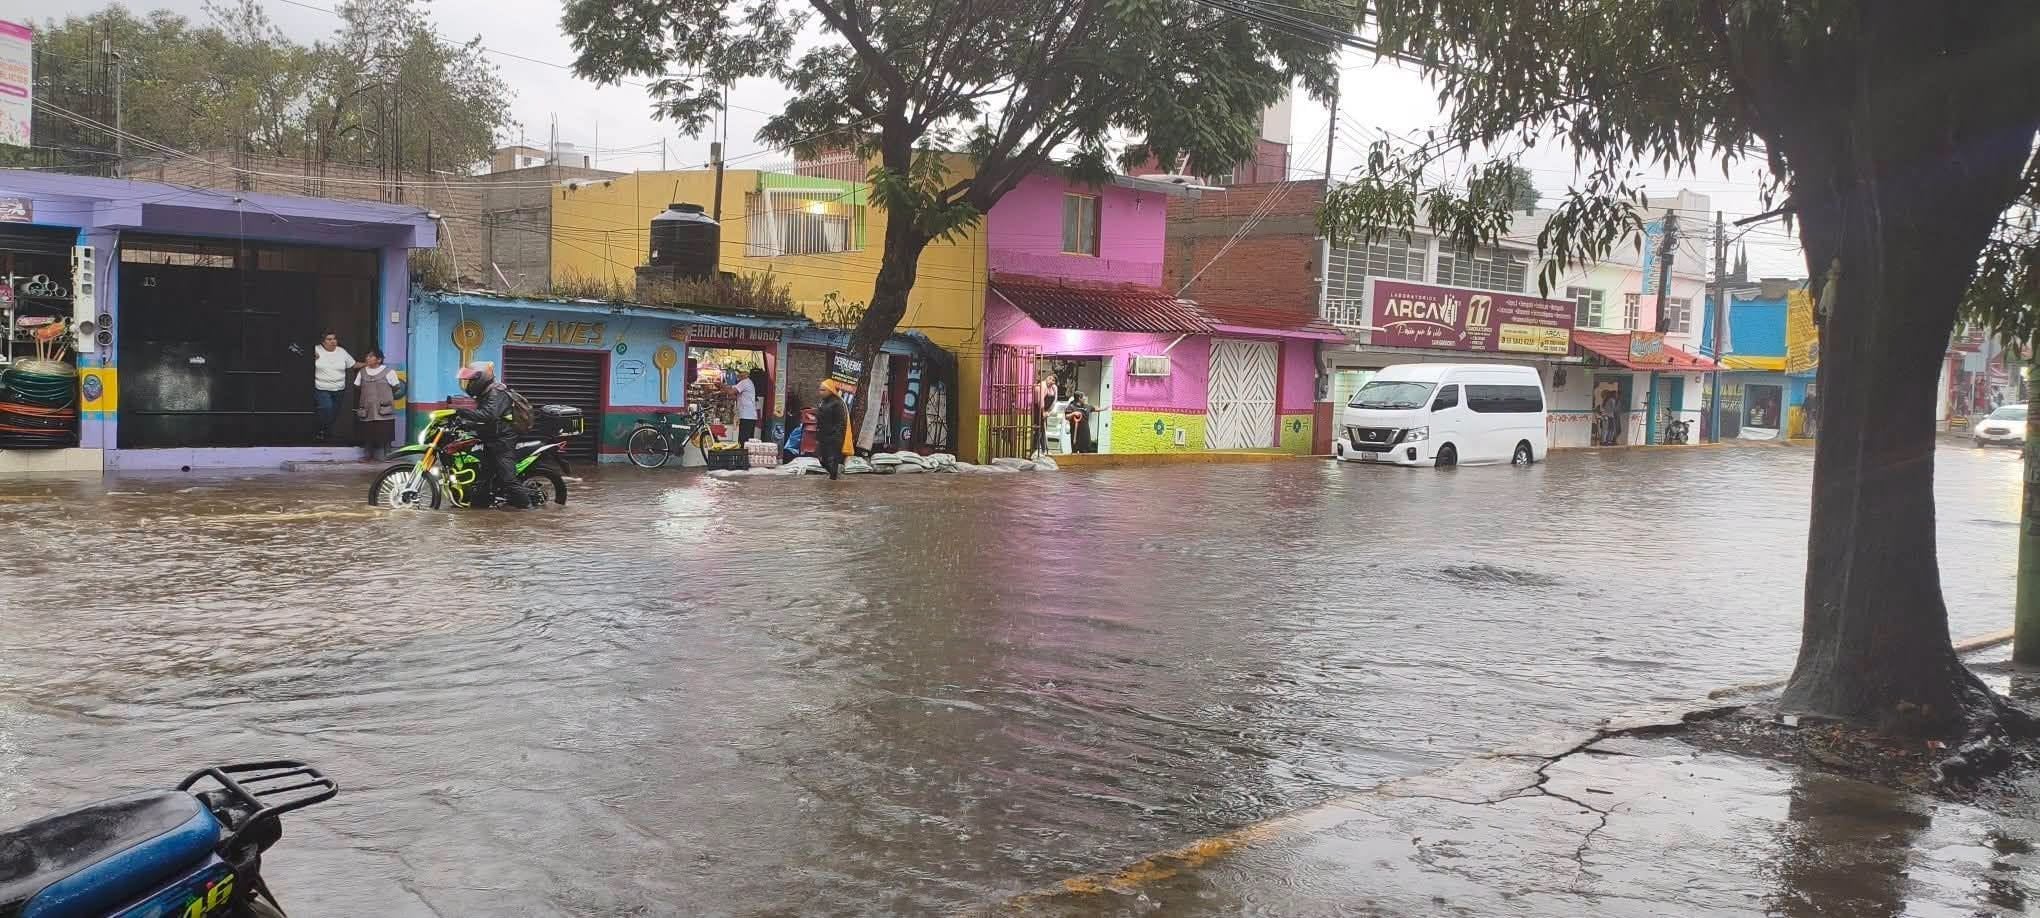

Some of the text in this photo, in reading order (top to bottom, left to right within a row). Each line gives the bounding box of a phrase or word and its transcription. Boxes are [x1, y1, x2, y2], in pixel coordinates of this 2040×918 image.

[1470, 298, 1490, 325] 11
[504, 319, 605, 346] LLAVES
[688, 323, 745, 340] ERRAJERIA
